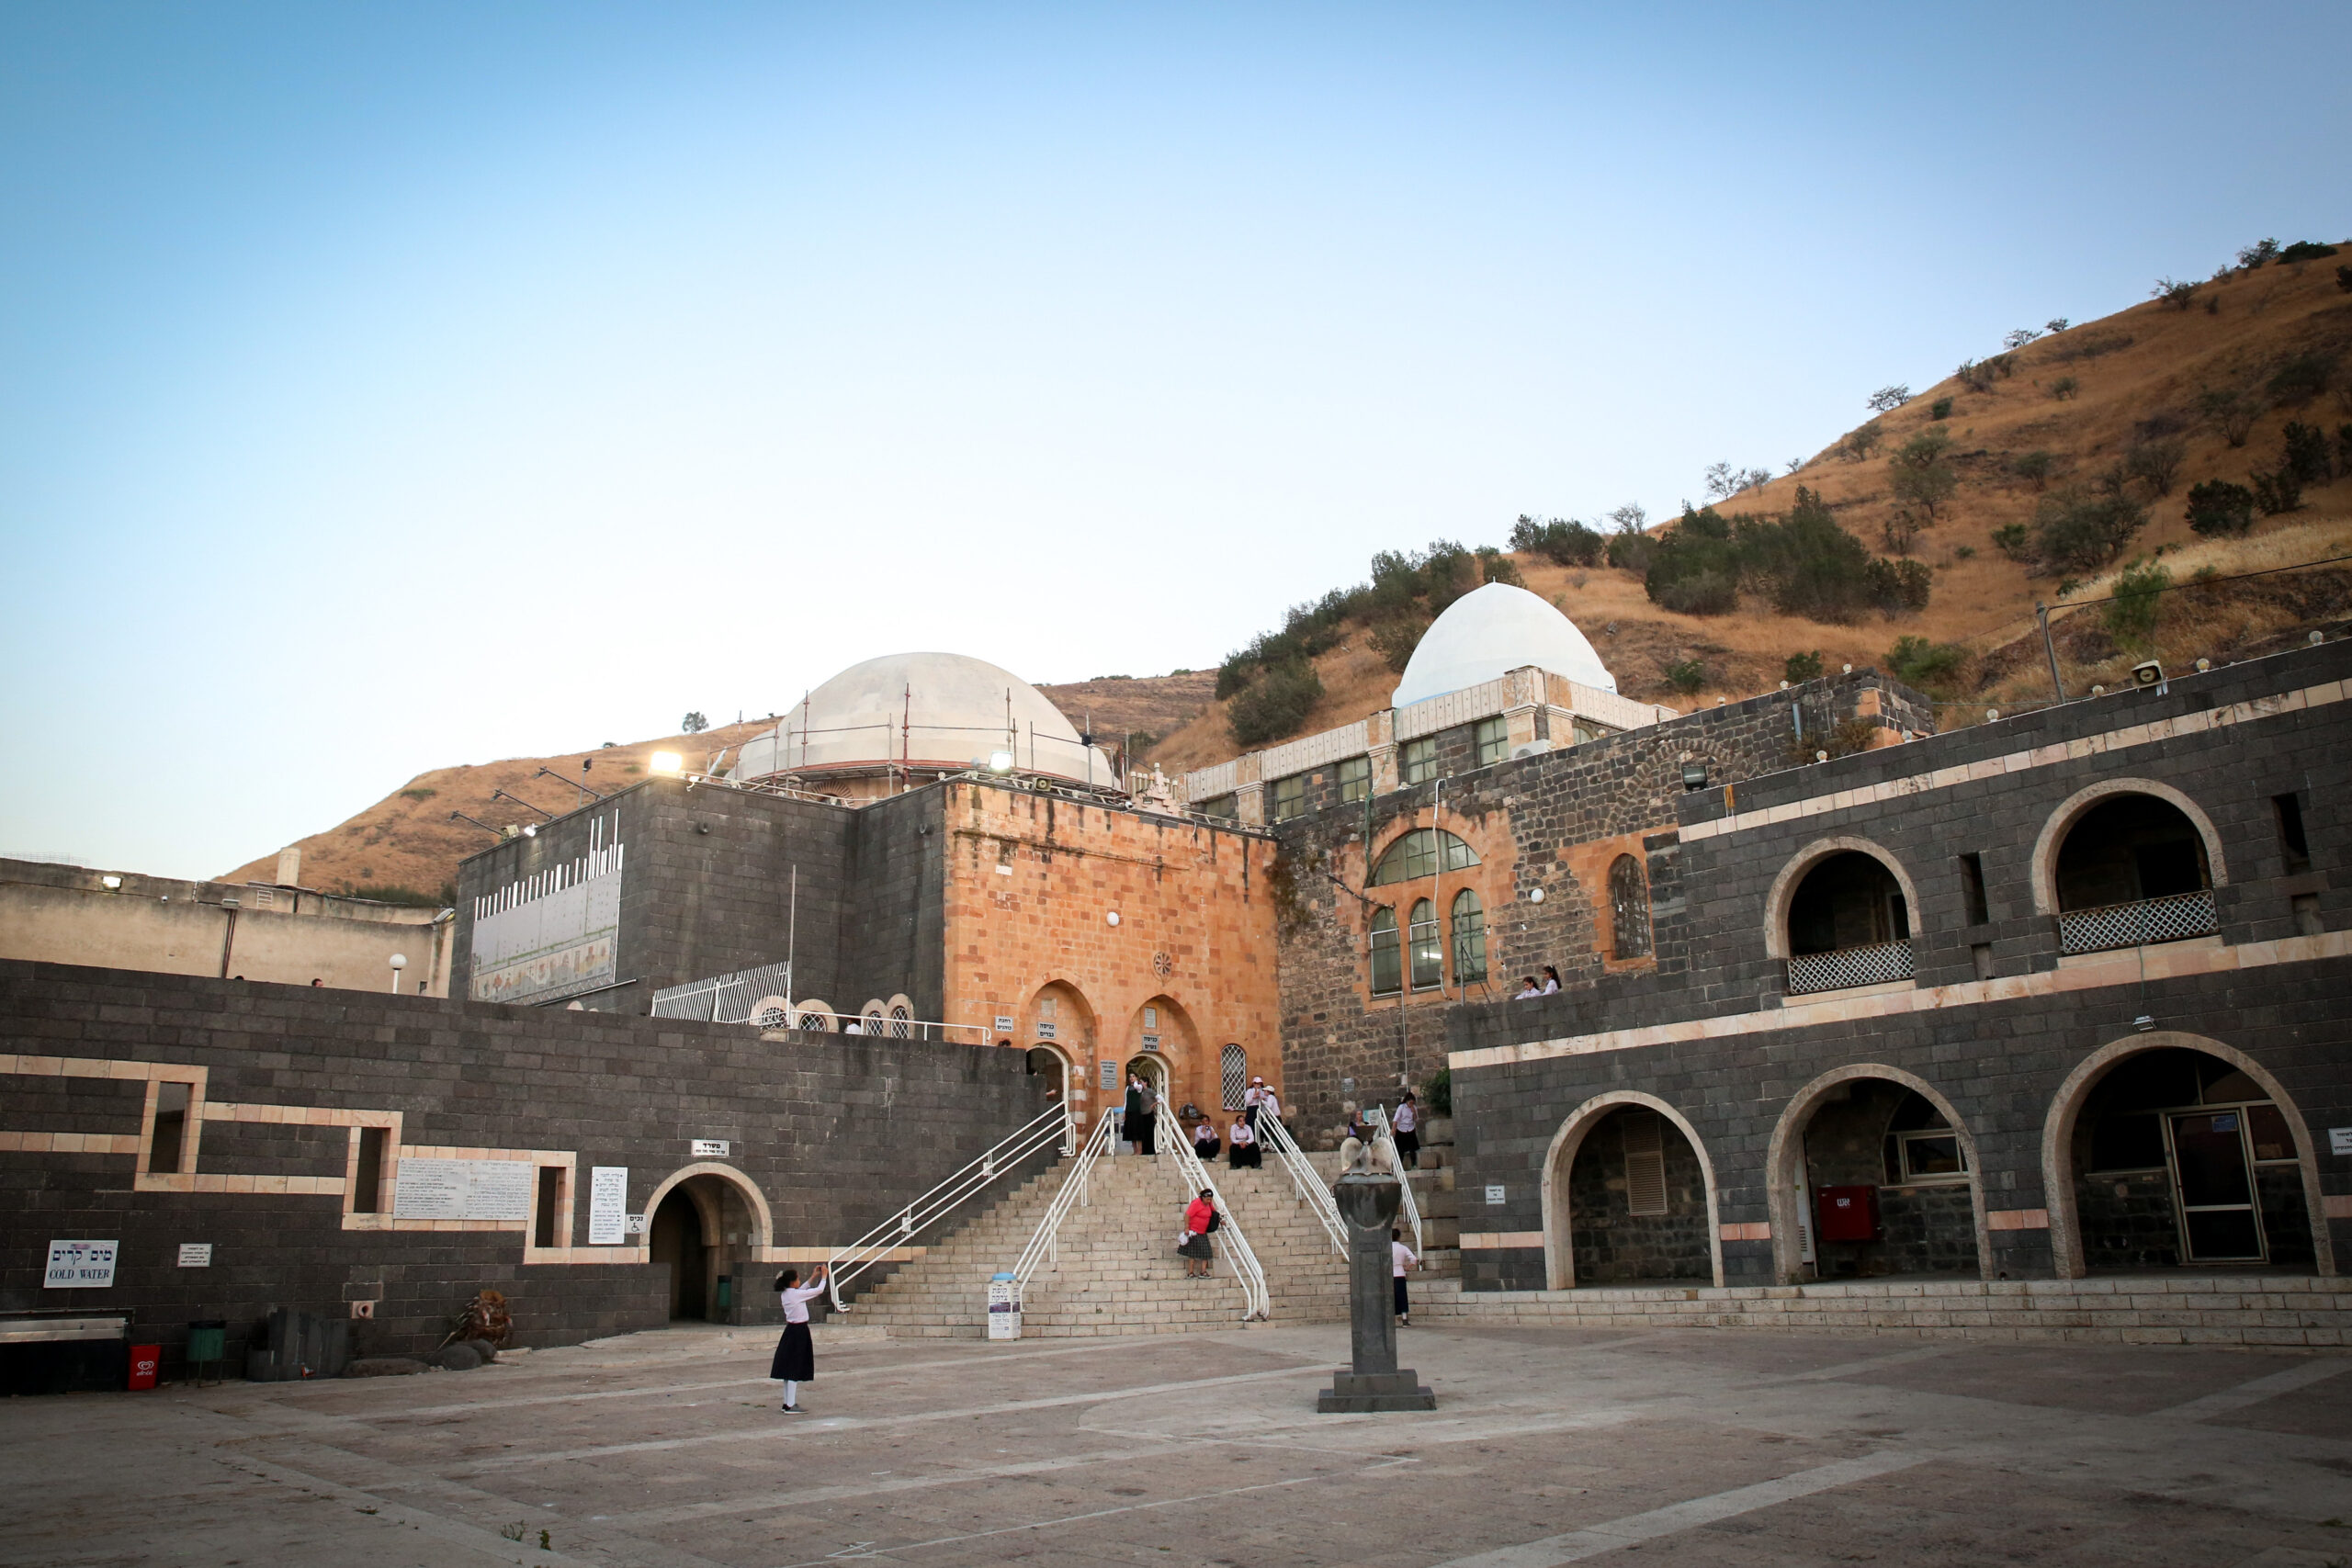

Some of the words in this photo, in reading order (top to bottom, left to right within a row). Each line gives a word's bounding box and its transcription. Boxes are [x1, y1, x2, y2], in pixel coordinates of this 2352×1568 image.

[1837, 1198, 1850, 1207] אש
[52, 1249, 83, 1265] קרים
[90, 1250, 112, 1261] מים
[49, 1269, 74, 1280] COLD
[80, 1269, 110, 1280] WATER
[992, 1287, 1008, 1295] קופת
